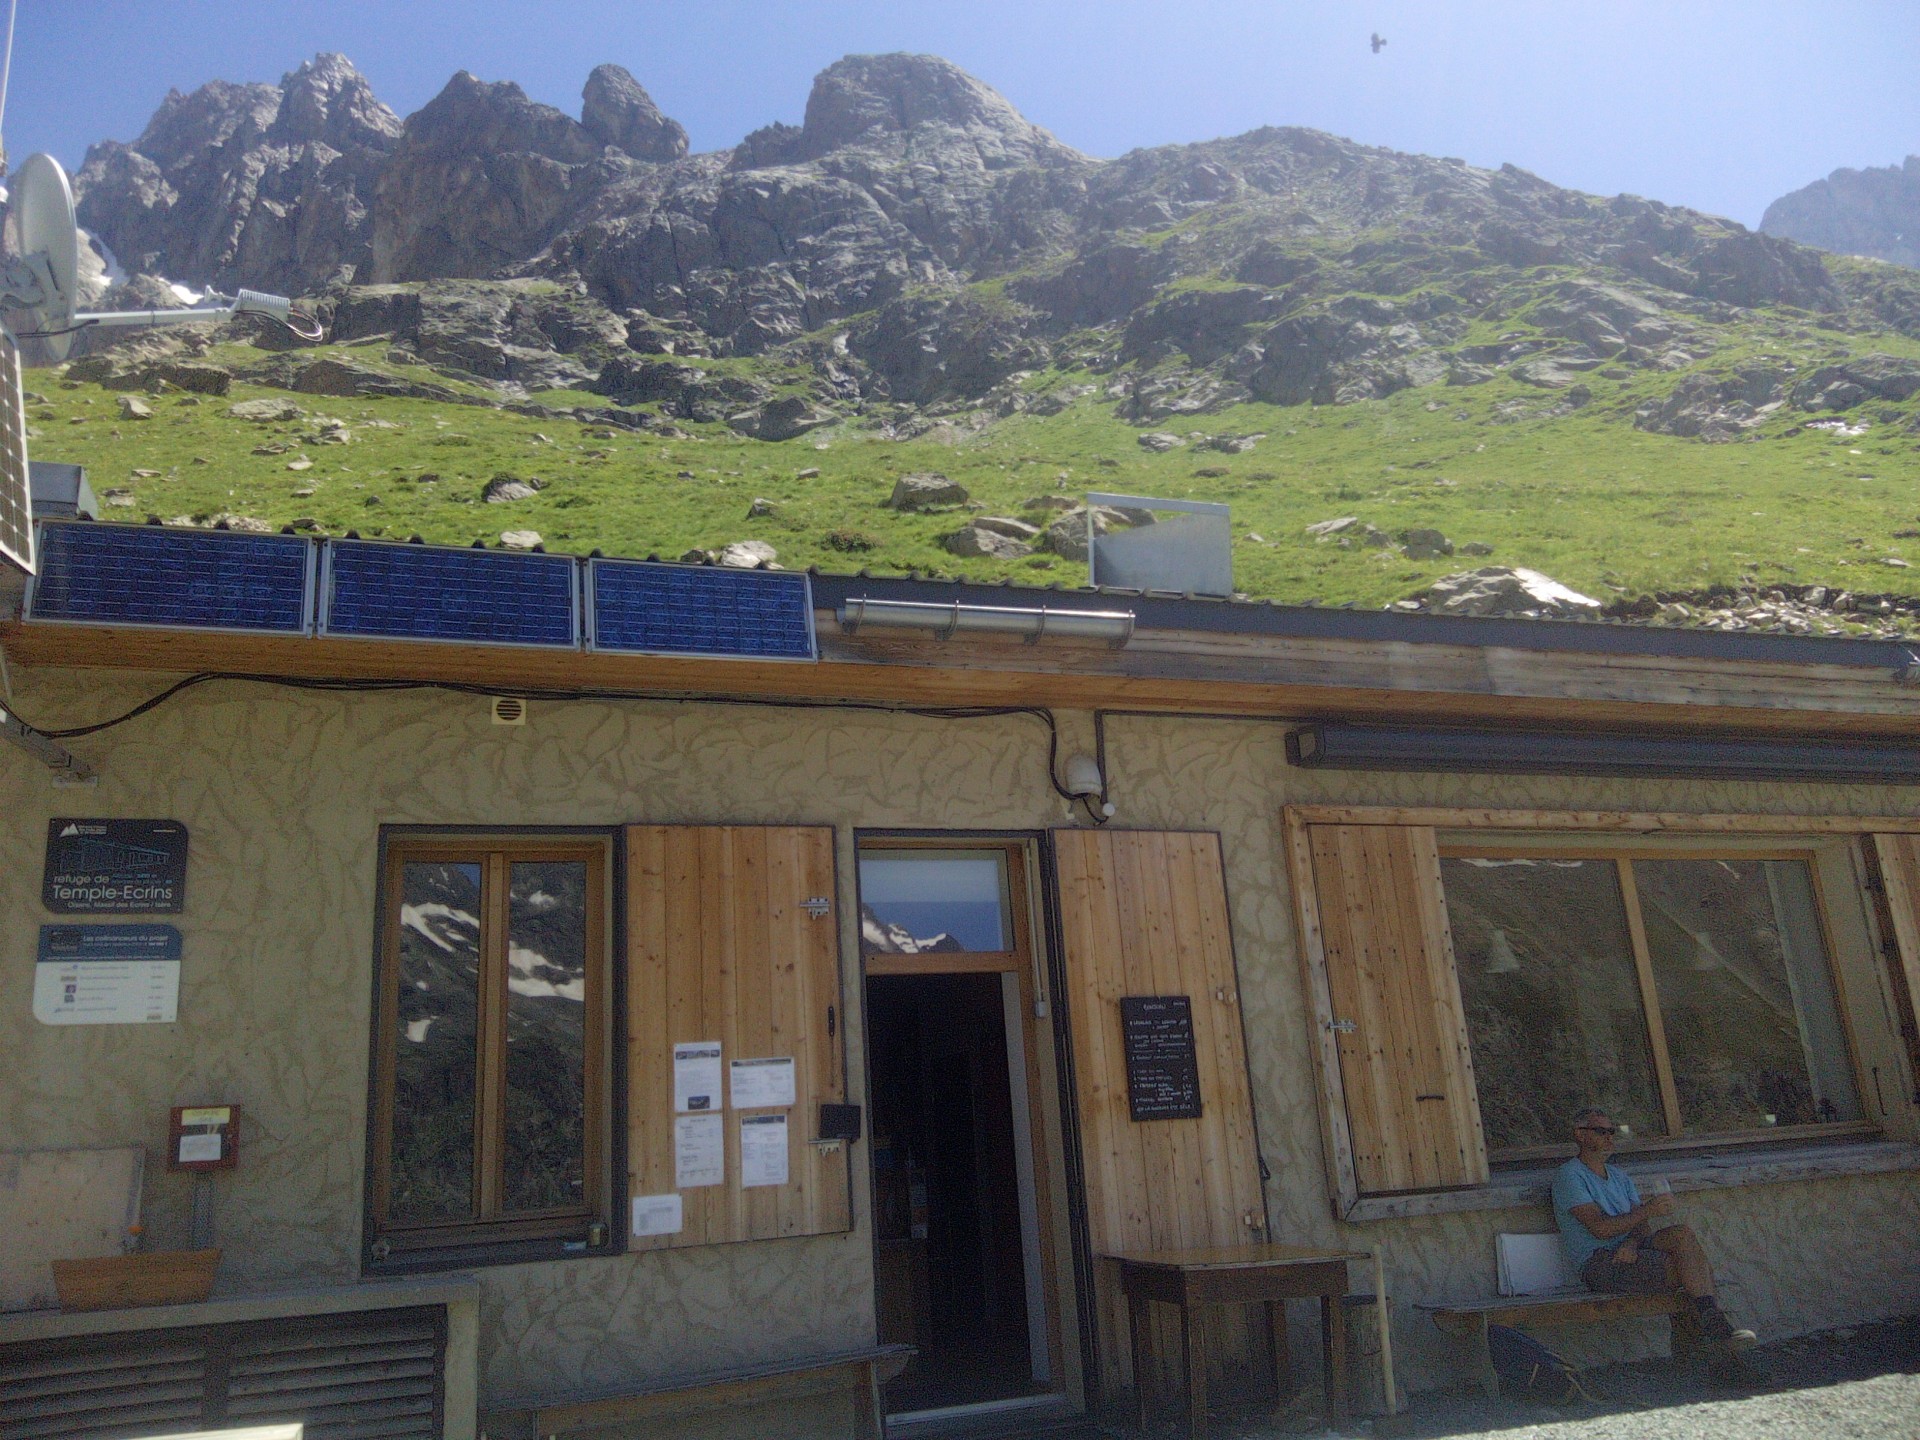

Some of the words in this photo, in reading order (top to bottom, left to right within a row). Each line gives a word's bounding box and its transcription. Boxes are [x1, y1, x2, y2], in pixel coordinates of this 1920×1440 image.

[53, 873, 92, 885] refuge
[94, 873, 110, 884] de
[52, 884, 173, 901] Temple-Ecrins
